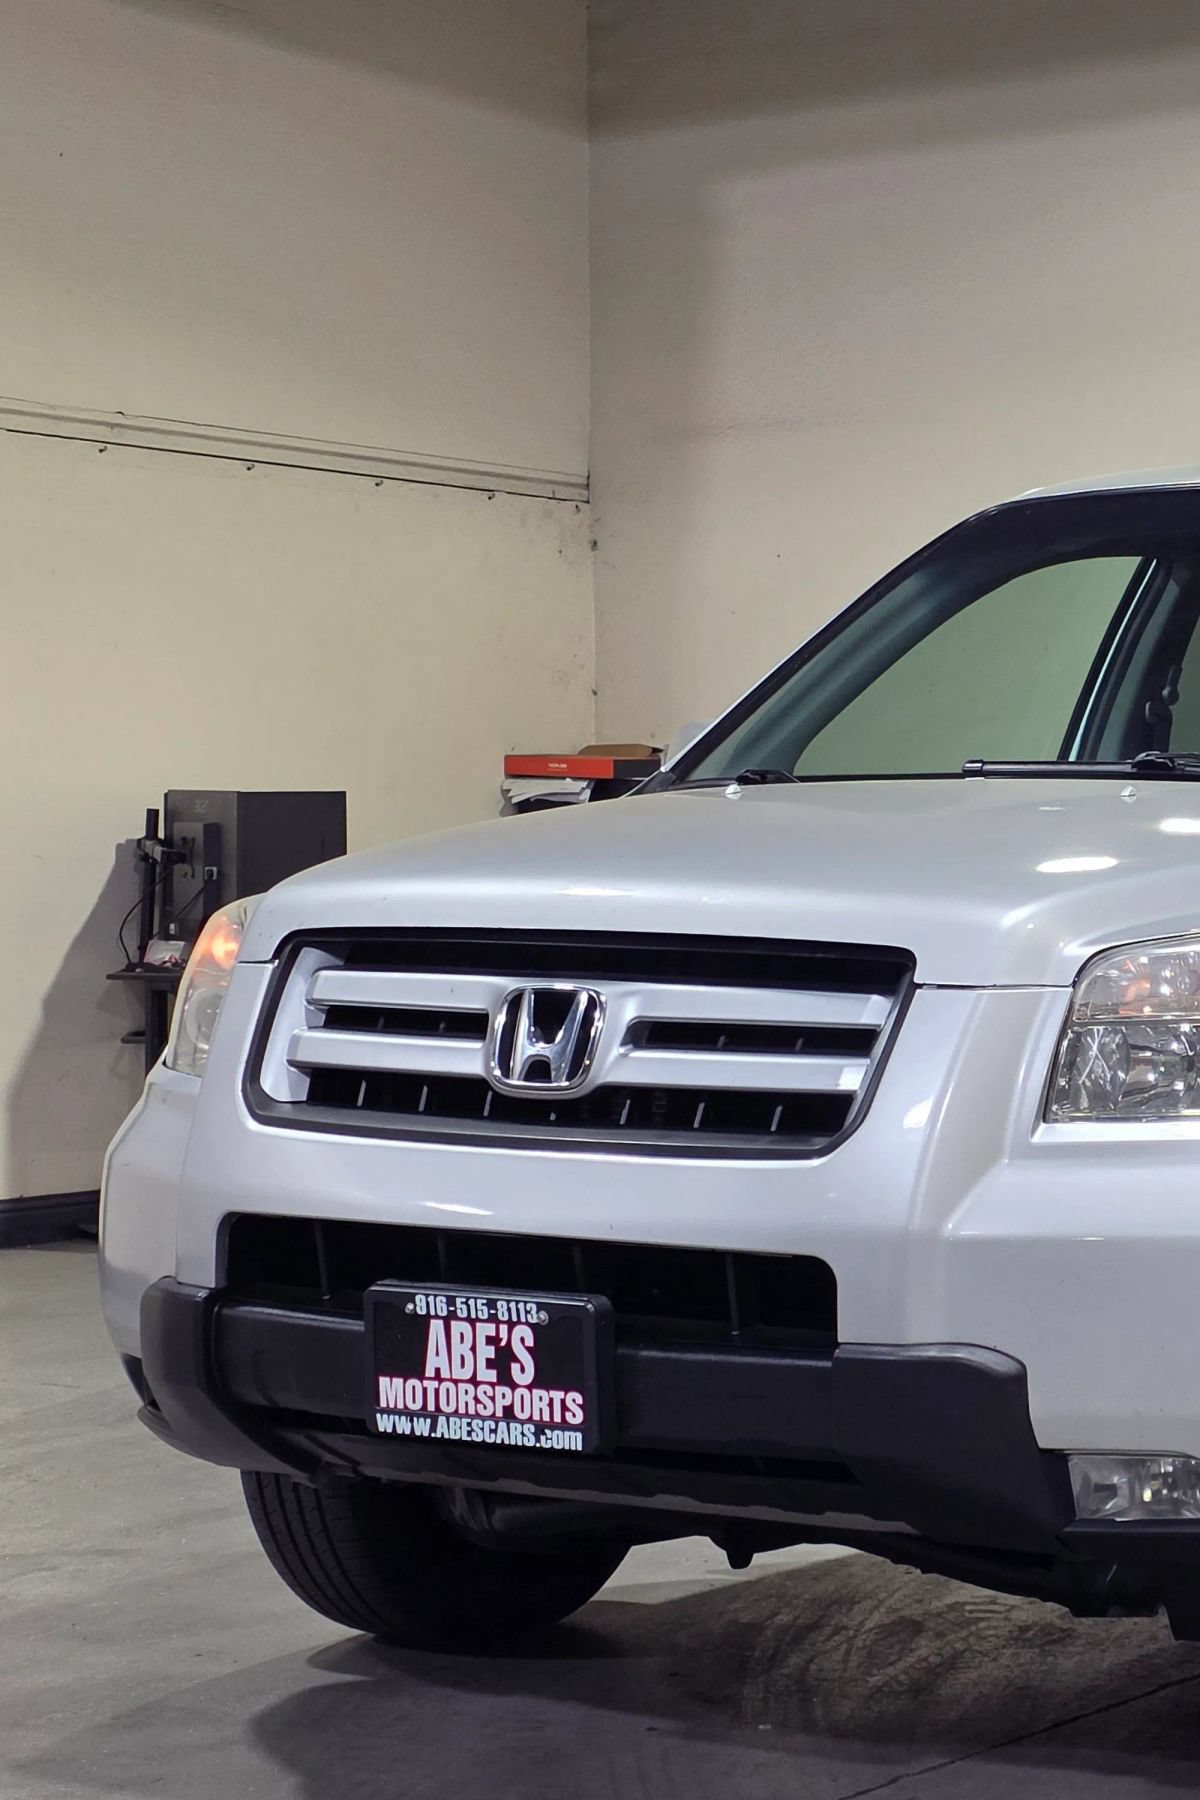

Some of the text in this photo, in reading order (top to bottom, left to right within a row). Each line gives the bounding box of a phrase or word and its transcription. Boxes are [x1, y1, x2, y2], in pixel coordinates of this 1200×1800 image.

[415, 1294, 538, 1324] 916-515-8113
[424, 1319, 535, 1386] ABE'S
[378, 1376, 584, 1425] MOTORSPORTS
